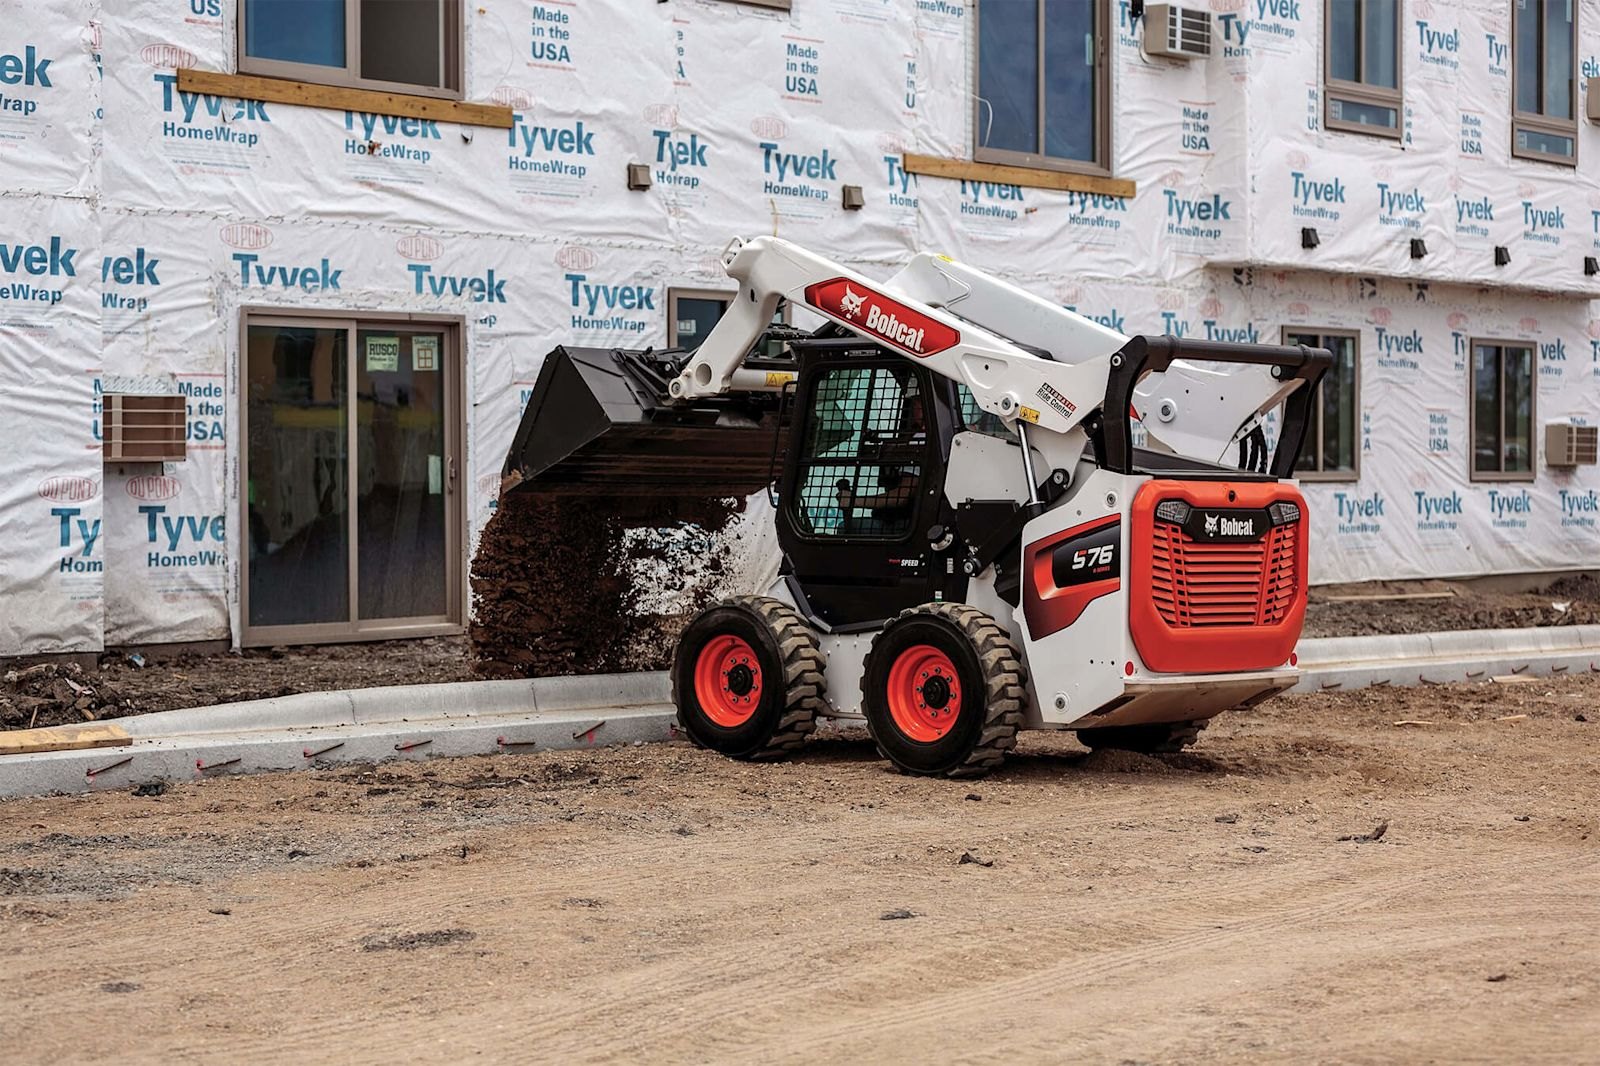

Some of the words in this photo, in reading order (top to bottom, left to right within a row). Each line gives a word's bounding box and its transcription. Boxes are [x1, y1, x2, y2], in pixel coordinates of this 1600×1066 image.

[532, 6, 569, 24] Made
[1251, 0, 1300, 20] yvek
[532, 22, 545, 37] in
[549, 26, 570, 40] the
[532, 41, 571, 63] USA
[787, 43, 818, 59] Made
[786, 59, 797, 72] in
[801, 62, 818, 75] the
[786, 76, 818, 95] USA
[0, 93, 37, 115] rap
[1183, 107, 1208, 120] Made
[164, 122, 258, 147] HomeWrap
[509, 114, 595, 157] Tyvek
[1193, 121, 1209, 133] the
[345, 140, 430, 164] HoeWrap
[1182, 135, 1210, 150] USA
[1461, 140, 1482, 154] USA
[509, 156, 586, 179] HomeWrap
[760, 142, 837, 182] Tyvek
[884, 156, 917, 194] Ty
[764, 181, 828, 201] HomeWrap
[1291, 172, 1345, 205] Tyvek
[1377, 183, 1426, 215] Tyvek
[961, 202, 1017, 221] HomeWrap
[1163, 189, 1232, 224] Tyvek
[1293, 205, 1340, 221] HomeWrap
[1454, 195, 1493, 223] yvek
[1522, 201, 1564, 231] Tyvek
[1069, 213, 1121, 230] HomeWrap
[565, 274, 655, 316] Tyvek
[572, 315, 645, 333] HomeWrap
[866, 304, 926, 352] Bobcat
[369, 343, 398, 356] RUSCO
[1375, 327, 1423, 357] Tyvek
[178, 382, 222, 398] Made
[1042, 382, 1077, 412] AUTOMATIC
[200, 400, 223, 416] the
[1036, 387, 1051, 402] Ride
[1050, 398, 1073, 418] Control
[1429, 439, 1449, 451] USA
[1334, 492, 1384, 523] Tyvek
[1414, 490, 1462, 520] Tyvek
[1488, 489, 1531, 518] Tyvek
[1559, 489, 1598, 517] Tyvek
[1221, 517, 1255, 536] Bobcat
[901, 559, 919, 567] SPEED
[1072, 545, 1114, 570] S76
